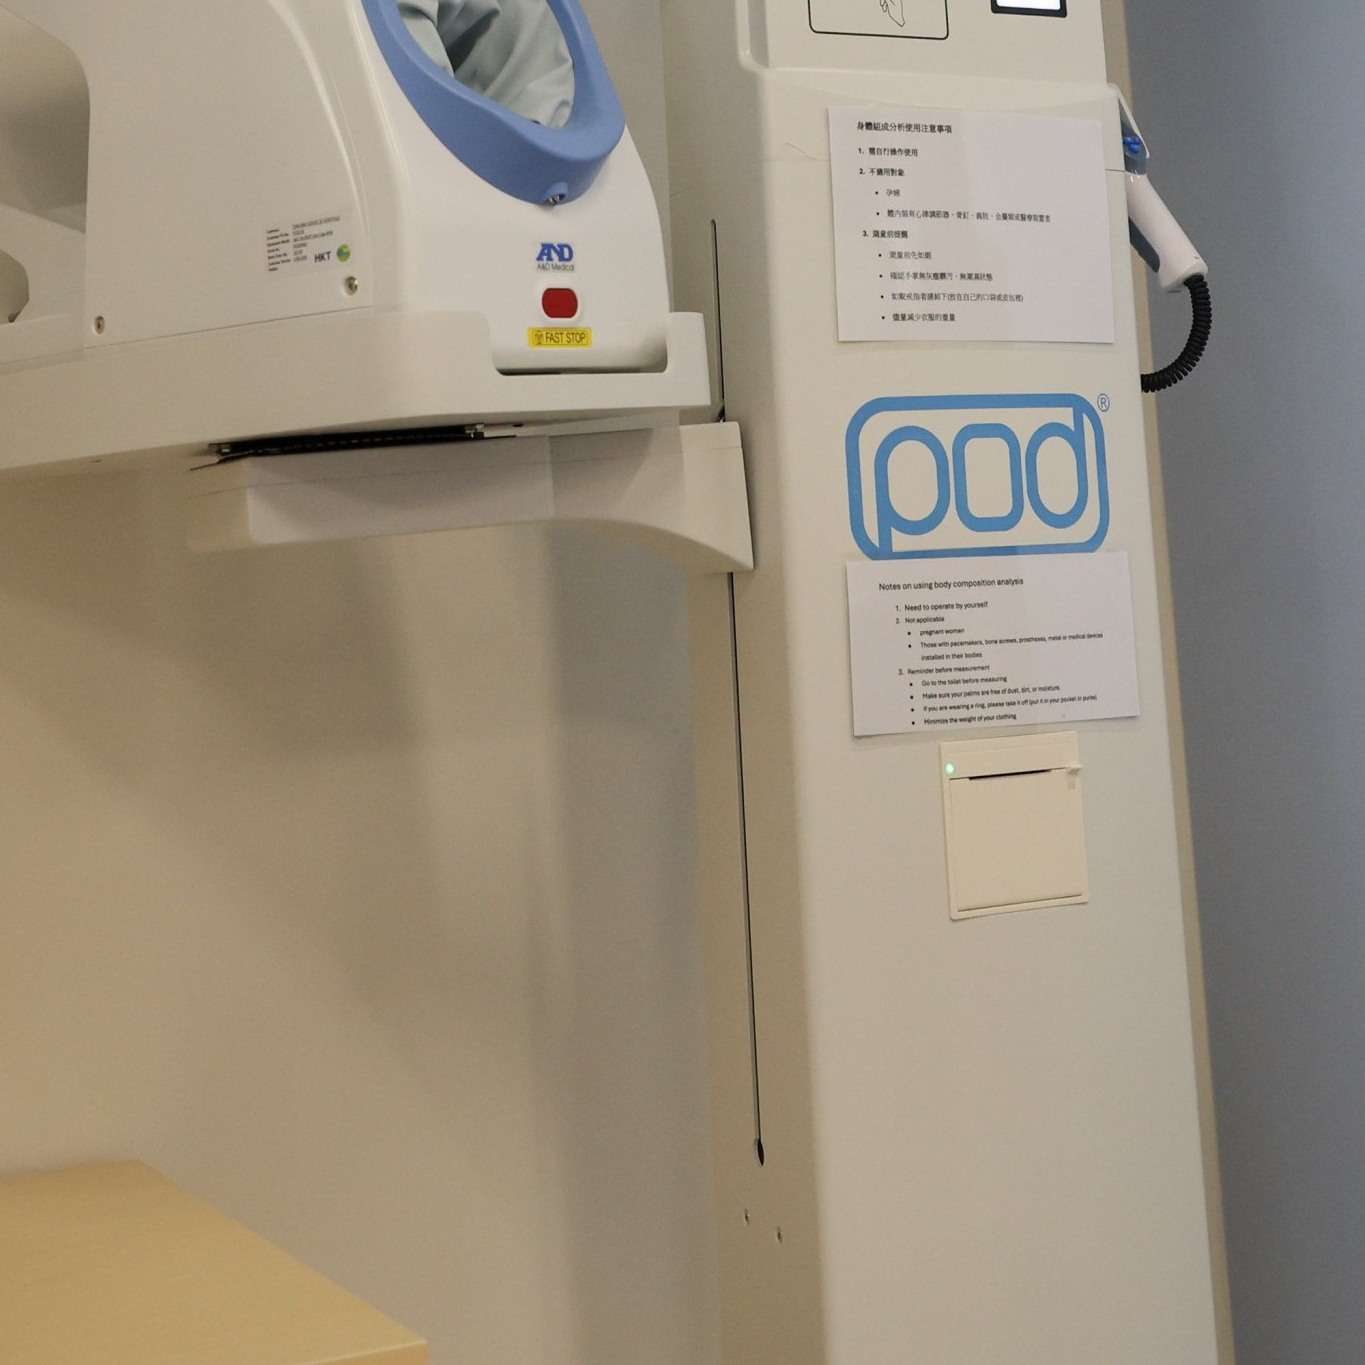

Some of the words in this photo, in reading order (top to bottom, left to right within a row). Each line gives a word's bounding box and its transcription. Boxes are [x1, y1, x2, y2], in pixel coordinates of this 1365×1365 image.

[857, 121, 952, 134] 身體組成分析使用注意事項
[858, 147, 865, 155] 1.
[859, 167, 866, 175] 2.
[314, 251, 332, 263] HKT
[551, 262, 575, 271] Medical
[545, 332, 564, 344] FAST
[566, 332, 586, 344] STOP
[873, 398, 1090, 557] pod
[878, 582, 901, 591] Notes
[913, 581, 933, 591] using
[934, 580, 952, 590] body
[953, 578, 996, 588] composition
[997, 578, 1024, 587] analysis
[904, 604, 922, 612] Need
[930, 603, 954, 612] operate
[955, 602, 963, 610] by
[964, 601, 988, 609] yourself
[916, 616, 945, 624] applicable
[920, 628, 944, 636] pregnant
[921, 653, 944, 661] installed
[951, 691, 962, 699] your
